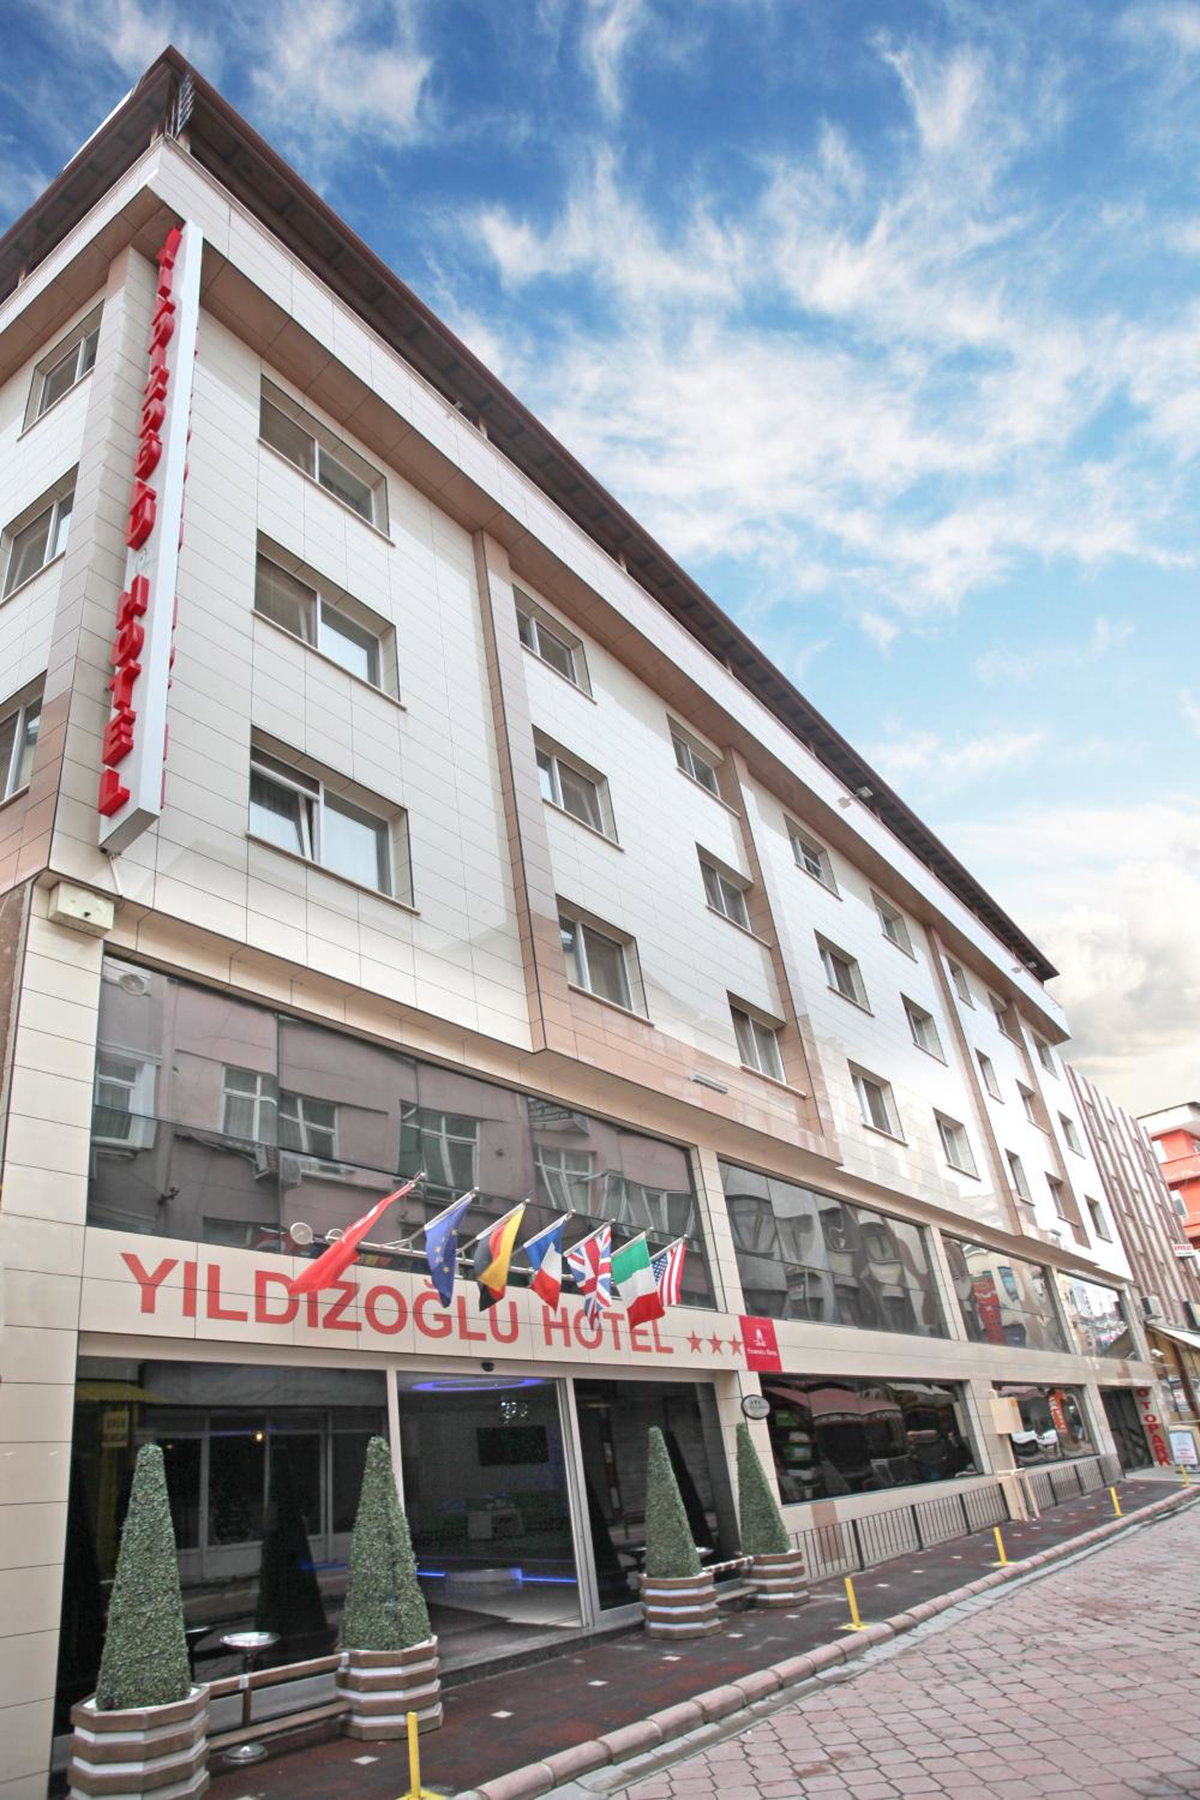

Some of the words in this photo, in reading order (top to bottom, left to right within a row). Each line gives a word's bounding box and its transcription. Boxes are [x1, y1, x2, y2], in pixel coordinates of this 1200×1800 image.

[97, 574, 150, 818] HOTEL
[542, 1304, 674, 1355] HOTEL
[1136, 1387, 1172, 1467] OTOPARK
